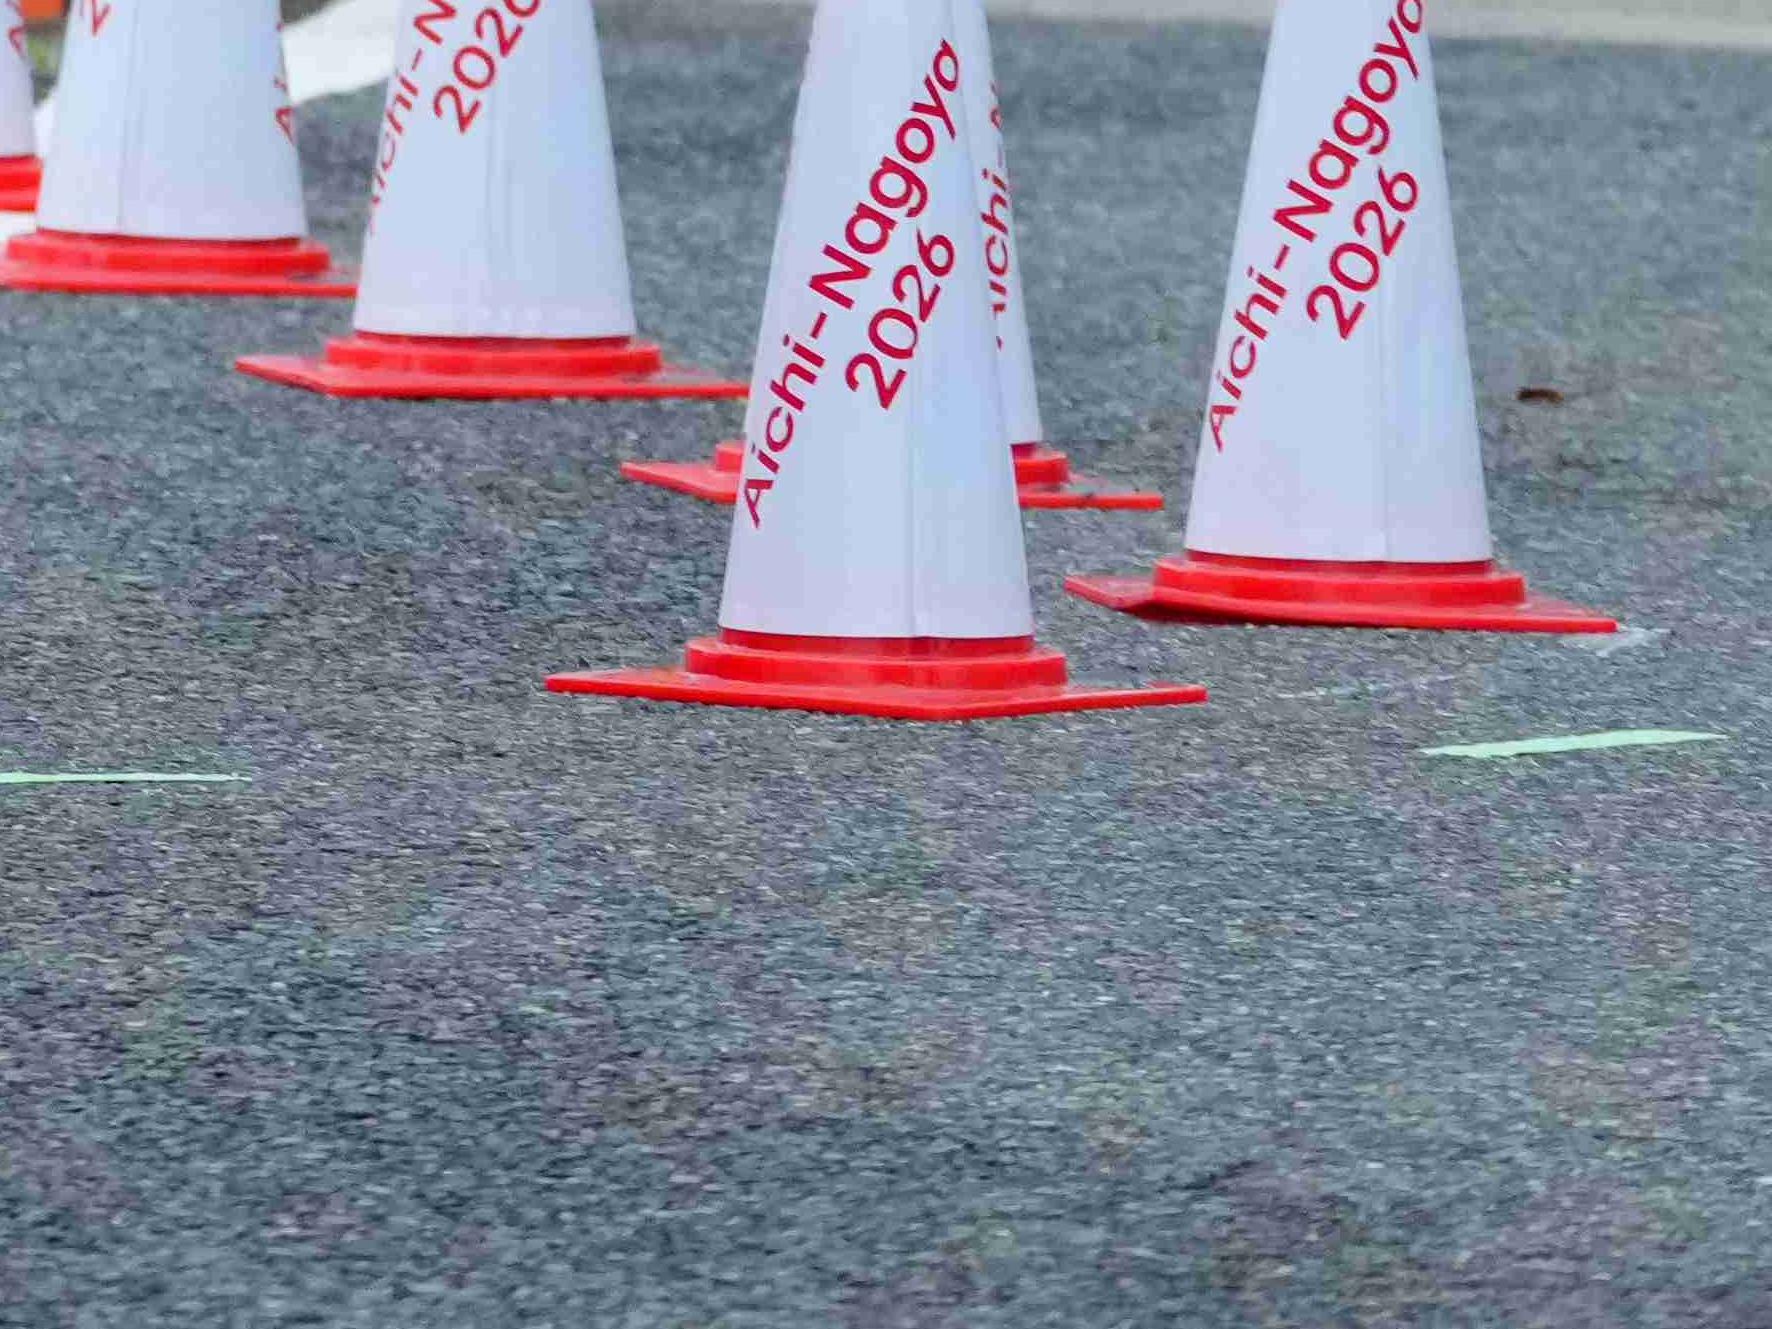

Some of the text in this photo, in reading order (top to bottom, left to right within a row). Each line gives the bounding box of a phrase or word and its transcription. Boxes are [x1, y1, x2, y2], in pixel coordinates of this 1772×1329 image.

[738, 38, 962, 528] Aichi-Nagoya
[844, 230, 956, 409] 2026
[1305, 166, 1420, 340] 2026
